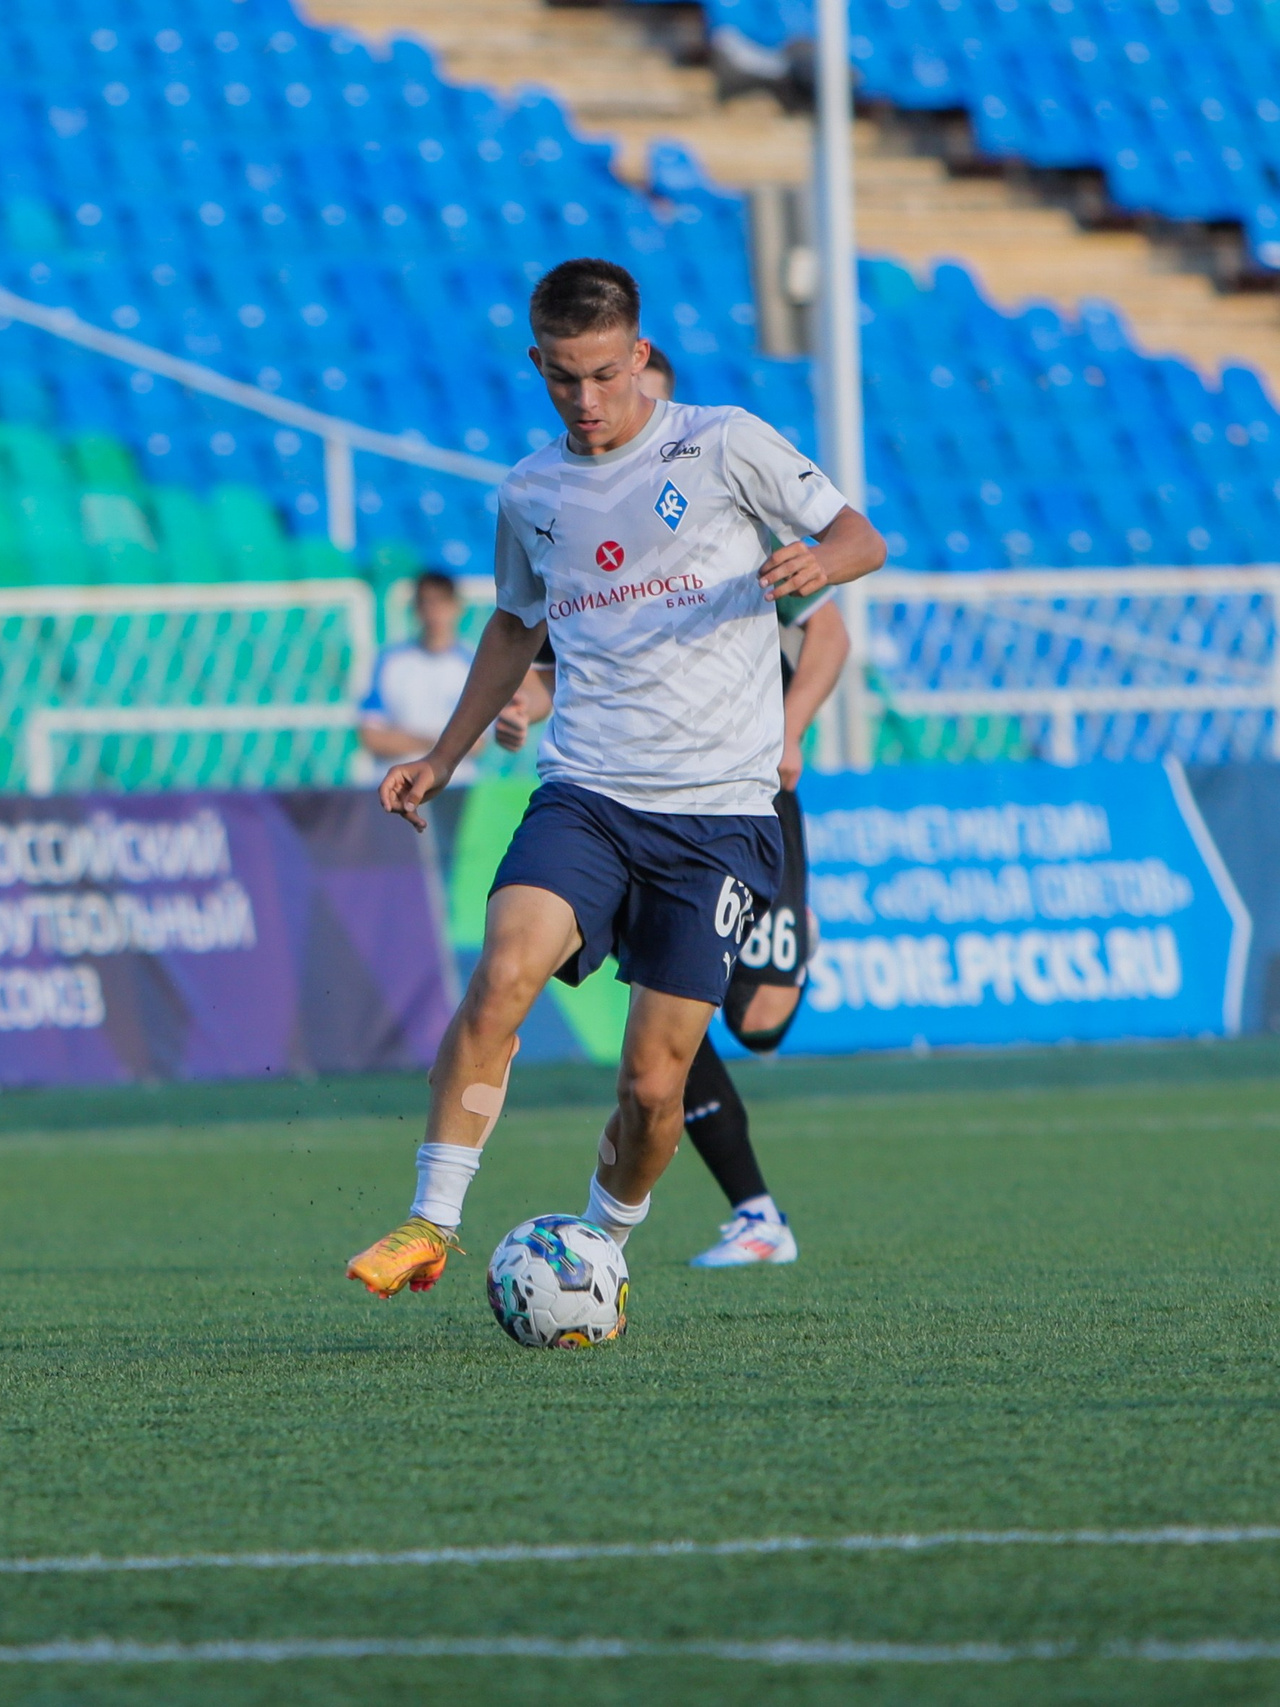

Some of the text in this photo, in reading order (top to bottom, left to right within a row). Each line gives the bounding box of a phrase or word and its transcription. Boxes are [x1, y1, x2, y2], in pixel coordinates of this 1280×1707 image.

[548, 573, 704, 621] СОЛИДАРНОСТЬ
[666, 593, 706, 609] БАНК
[740, 907, 797, 972] 86
